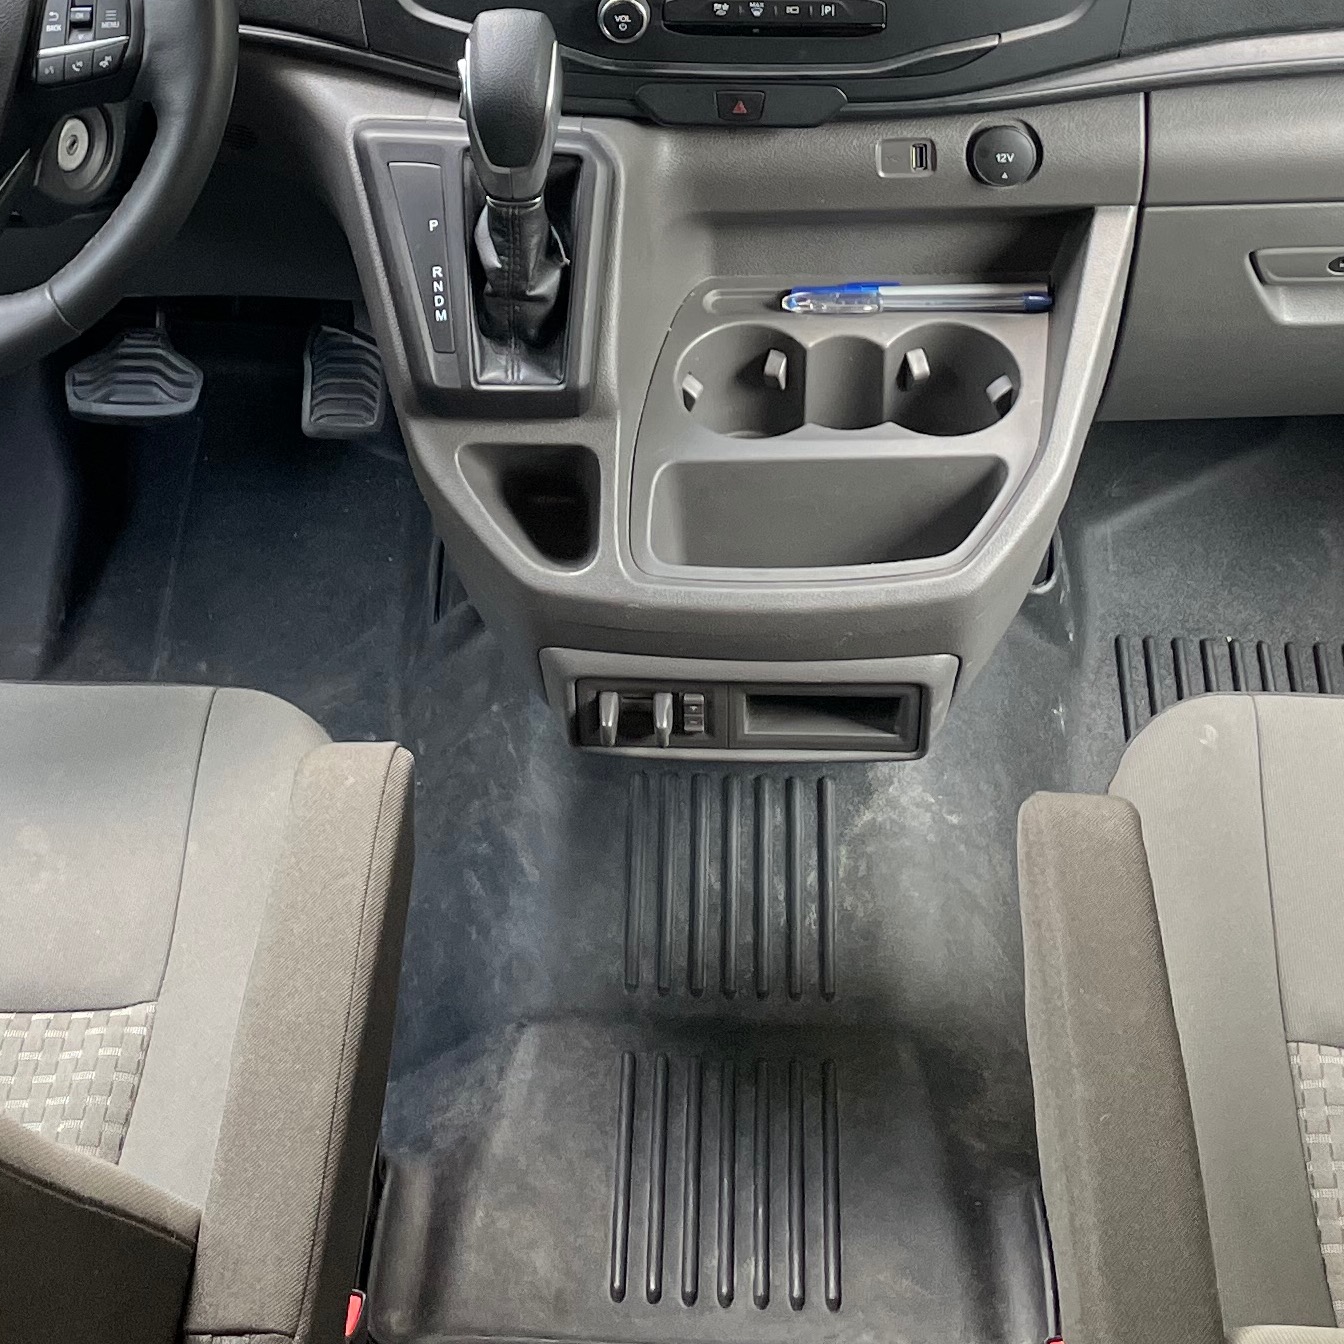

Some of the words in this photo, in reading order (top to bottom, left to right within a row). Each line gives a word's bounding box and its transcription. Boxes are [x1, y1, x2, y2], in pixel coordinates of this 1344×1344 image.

[46, 24, 62, 32] BACK
[995, 152, 1015, 163] 12V
[428, 219, 439, 232] P
[432, 266, 443, 278] R
[433, 280, 444, 293] N
[434, 295, 445, 307] D
[435, 309, 448, 322] M
